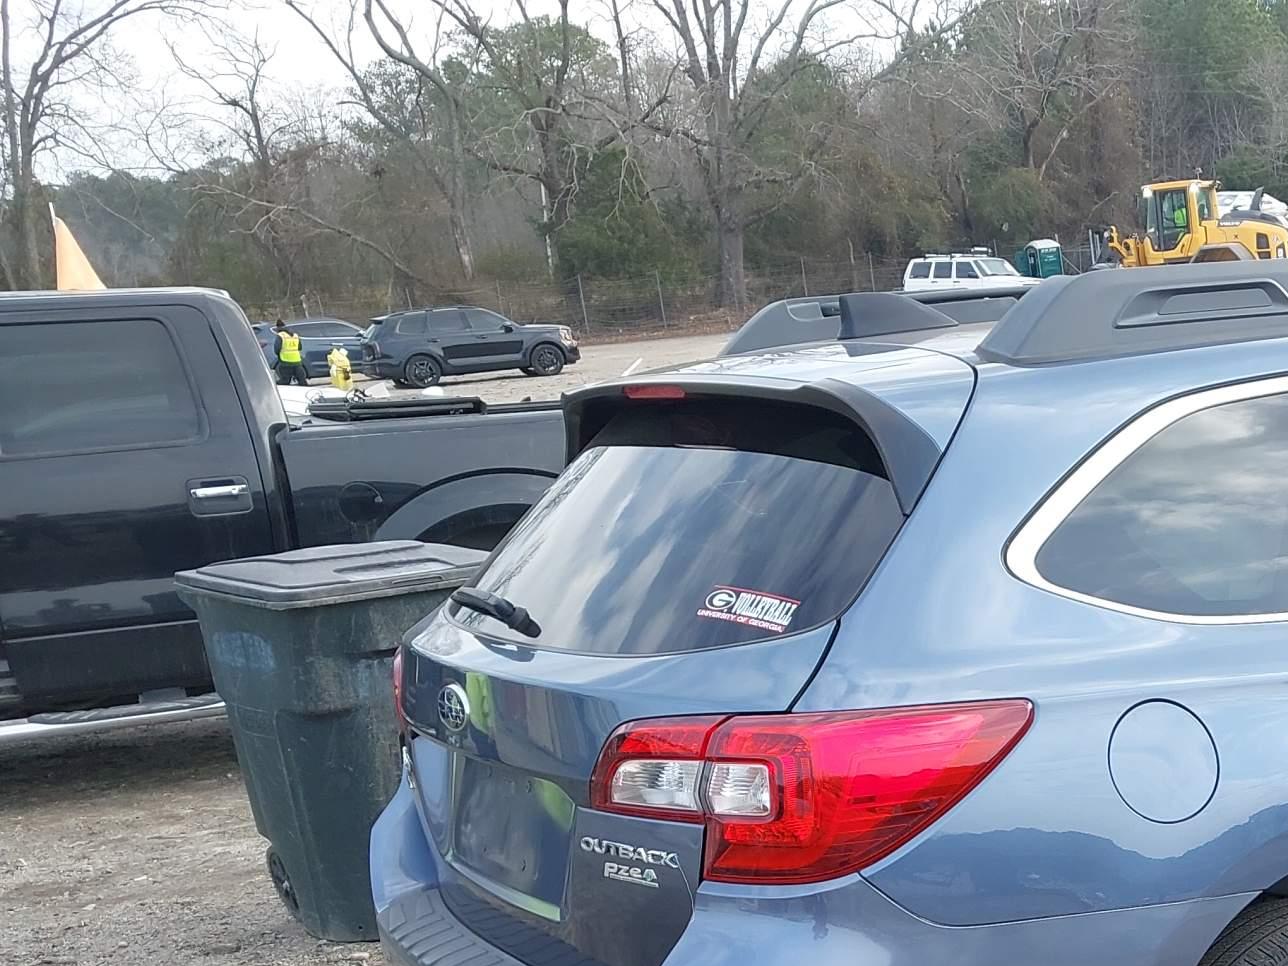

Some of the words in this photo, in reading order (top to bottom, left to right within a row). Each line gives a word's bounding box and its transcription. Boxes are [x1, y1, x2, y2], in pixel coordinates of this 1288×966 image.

[697, 609, 737, 622] UNIVERSITY
[737, 616, 748, 624] OF
[749, 618, 784, 633] GEORGIA
[731, 592, 798, 626] VOLLEYBALL
[580, 836, 680, 869] OUTBACK
